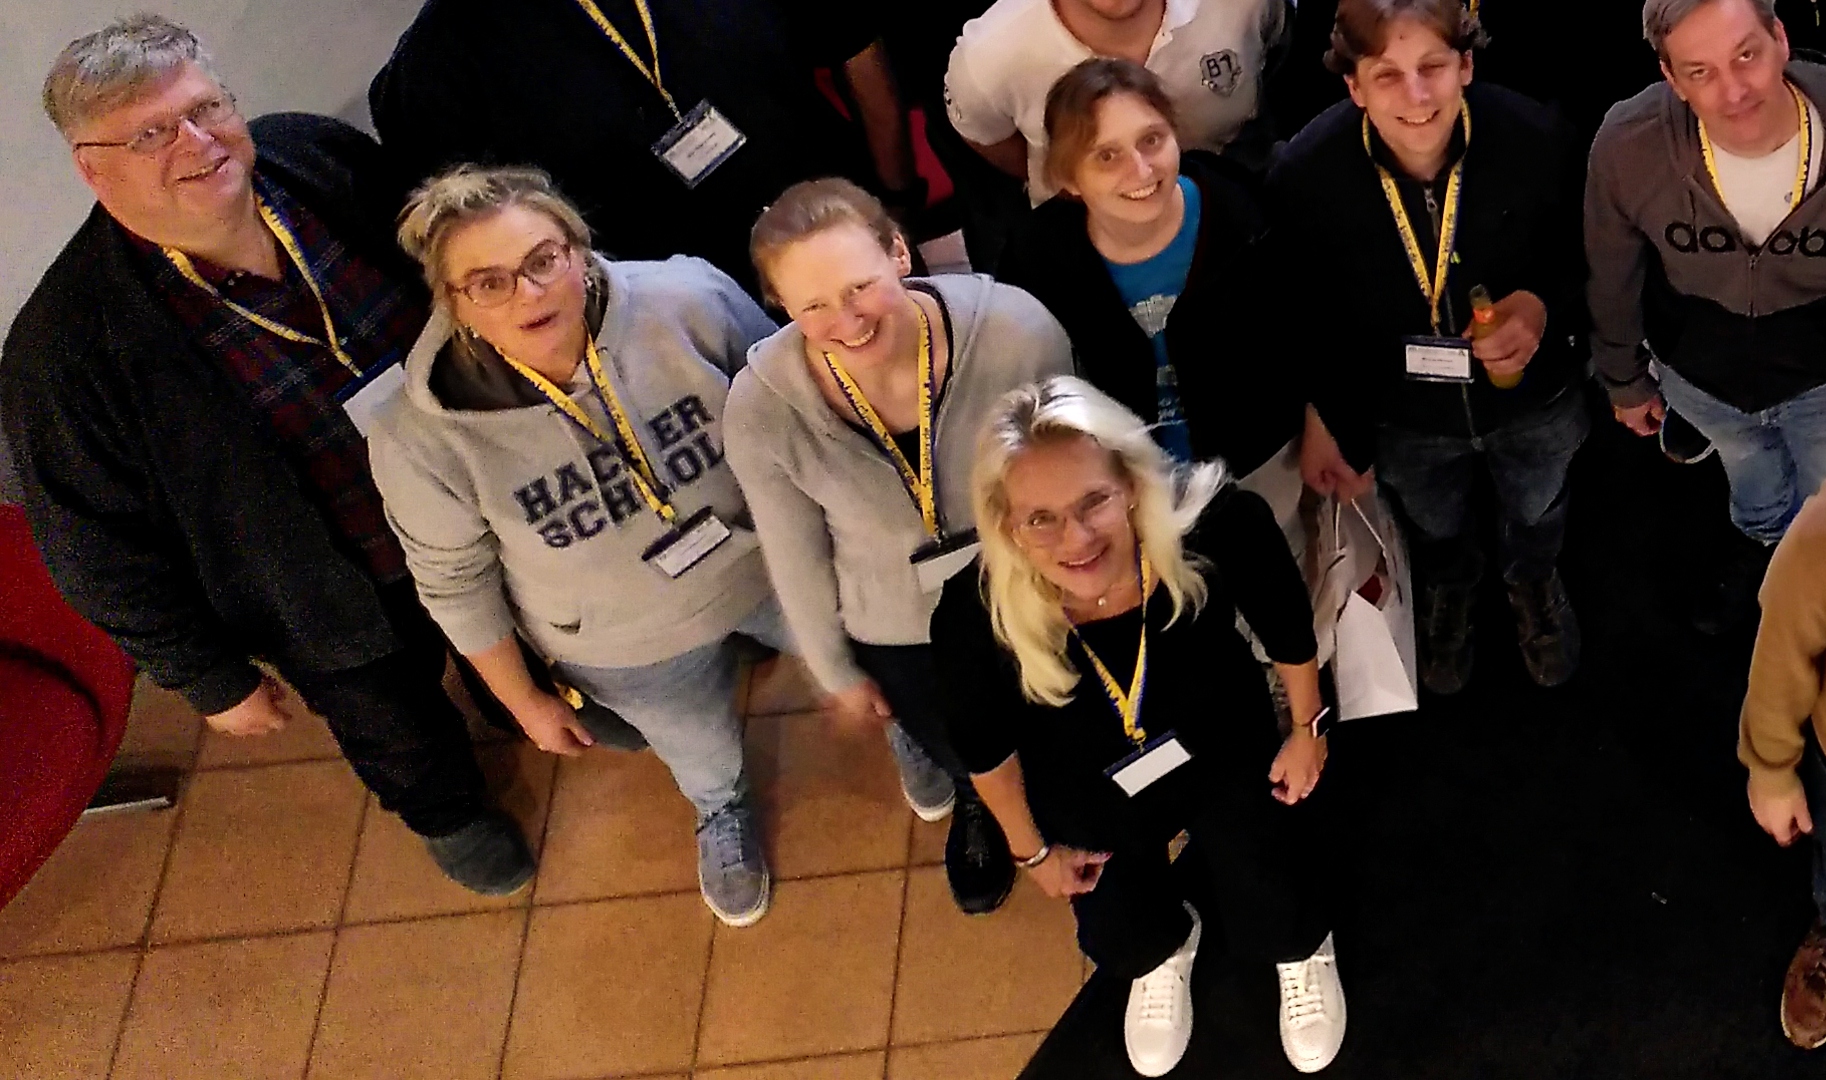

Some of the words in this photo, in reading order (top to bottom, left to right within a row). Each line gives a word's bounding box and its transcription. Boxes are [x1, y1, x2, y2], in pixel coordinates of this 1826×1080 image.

[1206, 53, 1233, 78] B1
[514, 395, 715, 525] HACER
[537, 431, 727, 550] SCHOL
